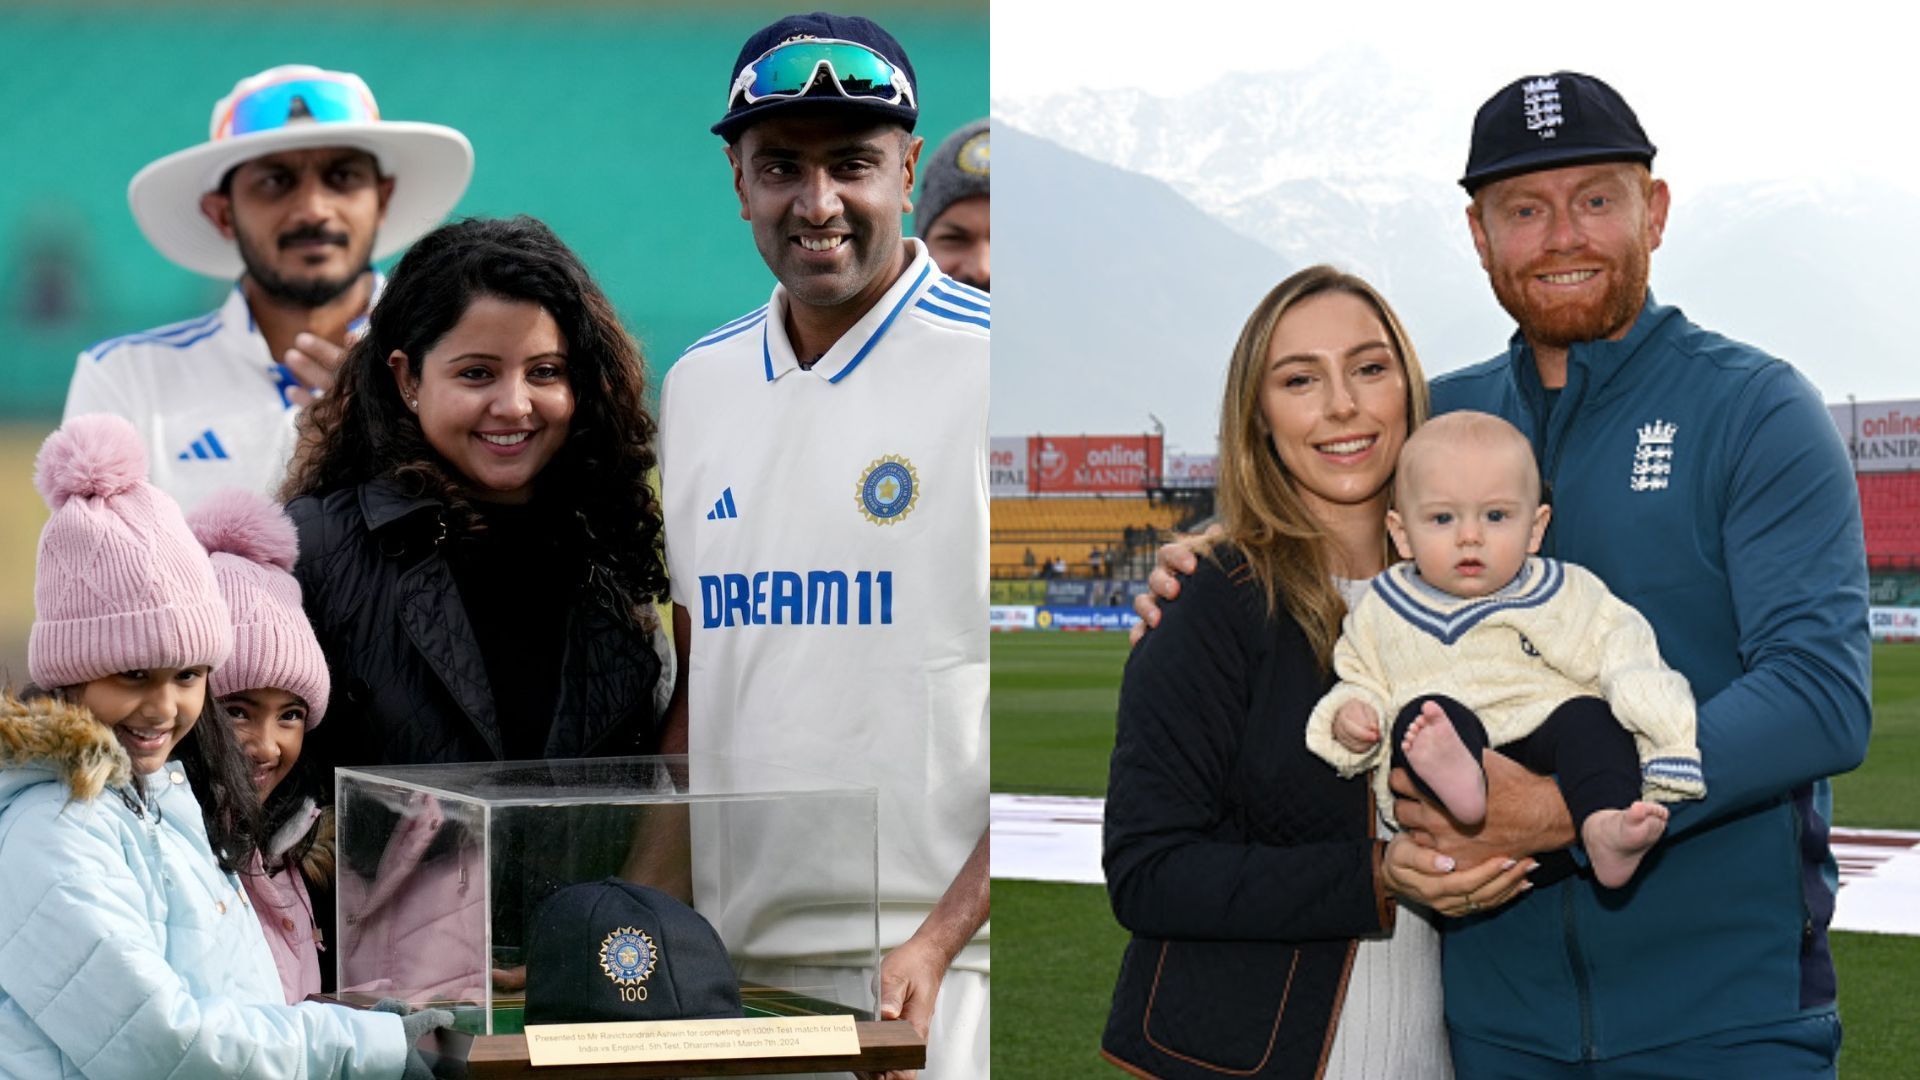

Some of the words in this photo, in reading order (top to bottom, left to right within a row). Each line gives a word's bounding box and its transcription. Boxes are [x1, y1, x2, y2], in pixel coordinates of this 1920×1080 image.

[1087, 444, 1146, 466] online
[1849, 439, 1920, 460] MANIP
[698, 570, 892, 629] DREAM11
[619, 986, 647, 1001] 100
[535, 1034, 576, 1042] Presented
[600, 1031, 655, 1039] Ravichandran
[686, 1029, 695, 1037] for
[700, 1028, 740, 1037] competing
[753, 1026, 774, 1034] 100th
[795, 1025, 819, 1033] match
[834, 1024, 853, 1032] India
[649, 1042, 662, 1050] 5th
[738, 1039, 762, 1047] March
[780, 1038, 800, 1046] 2024
